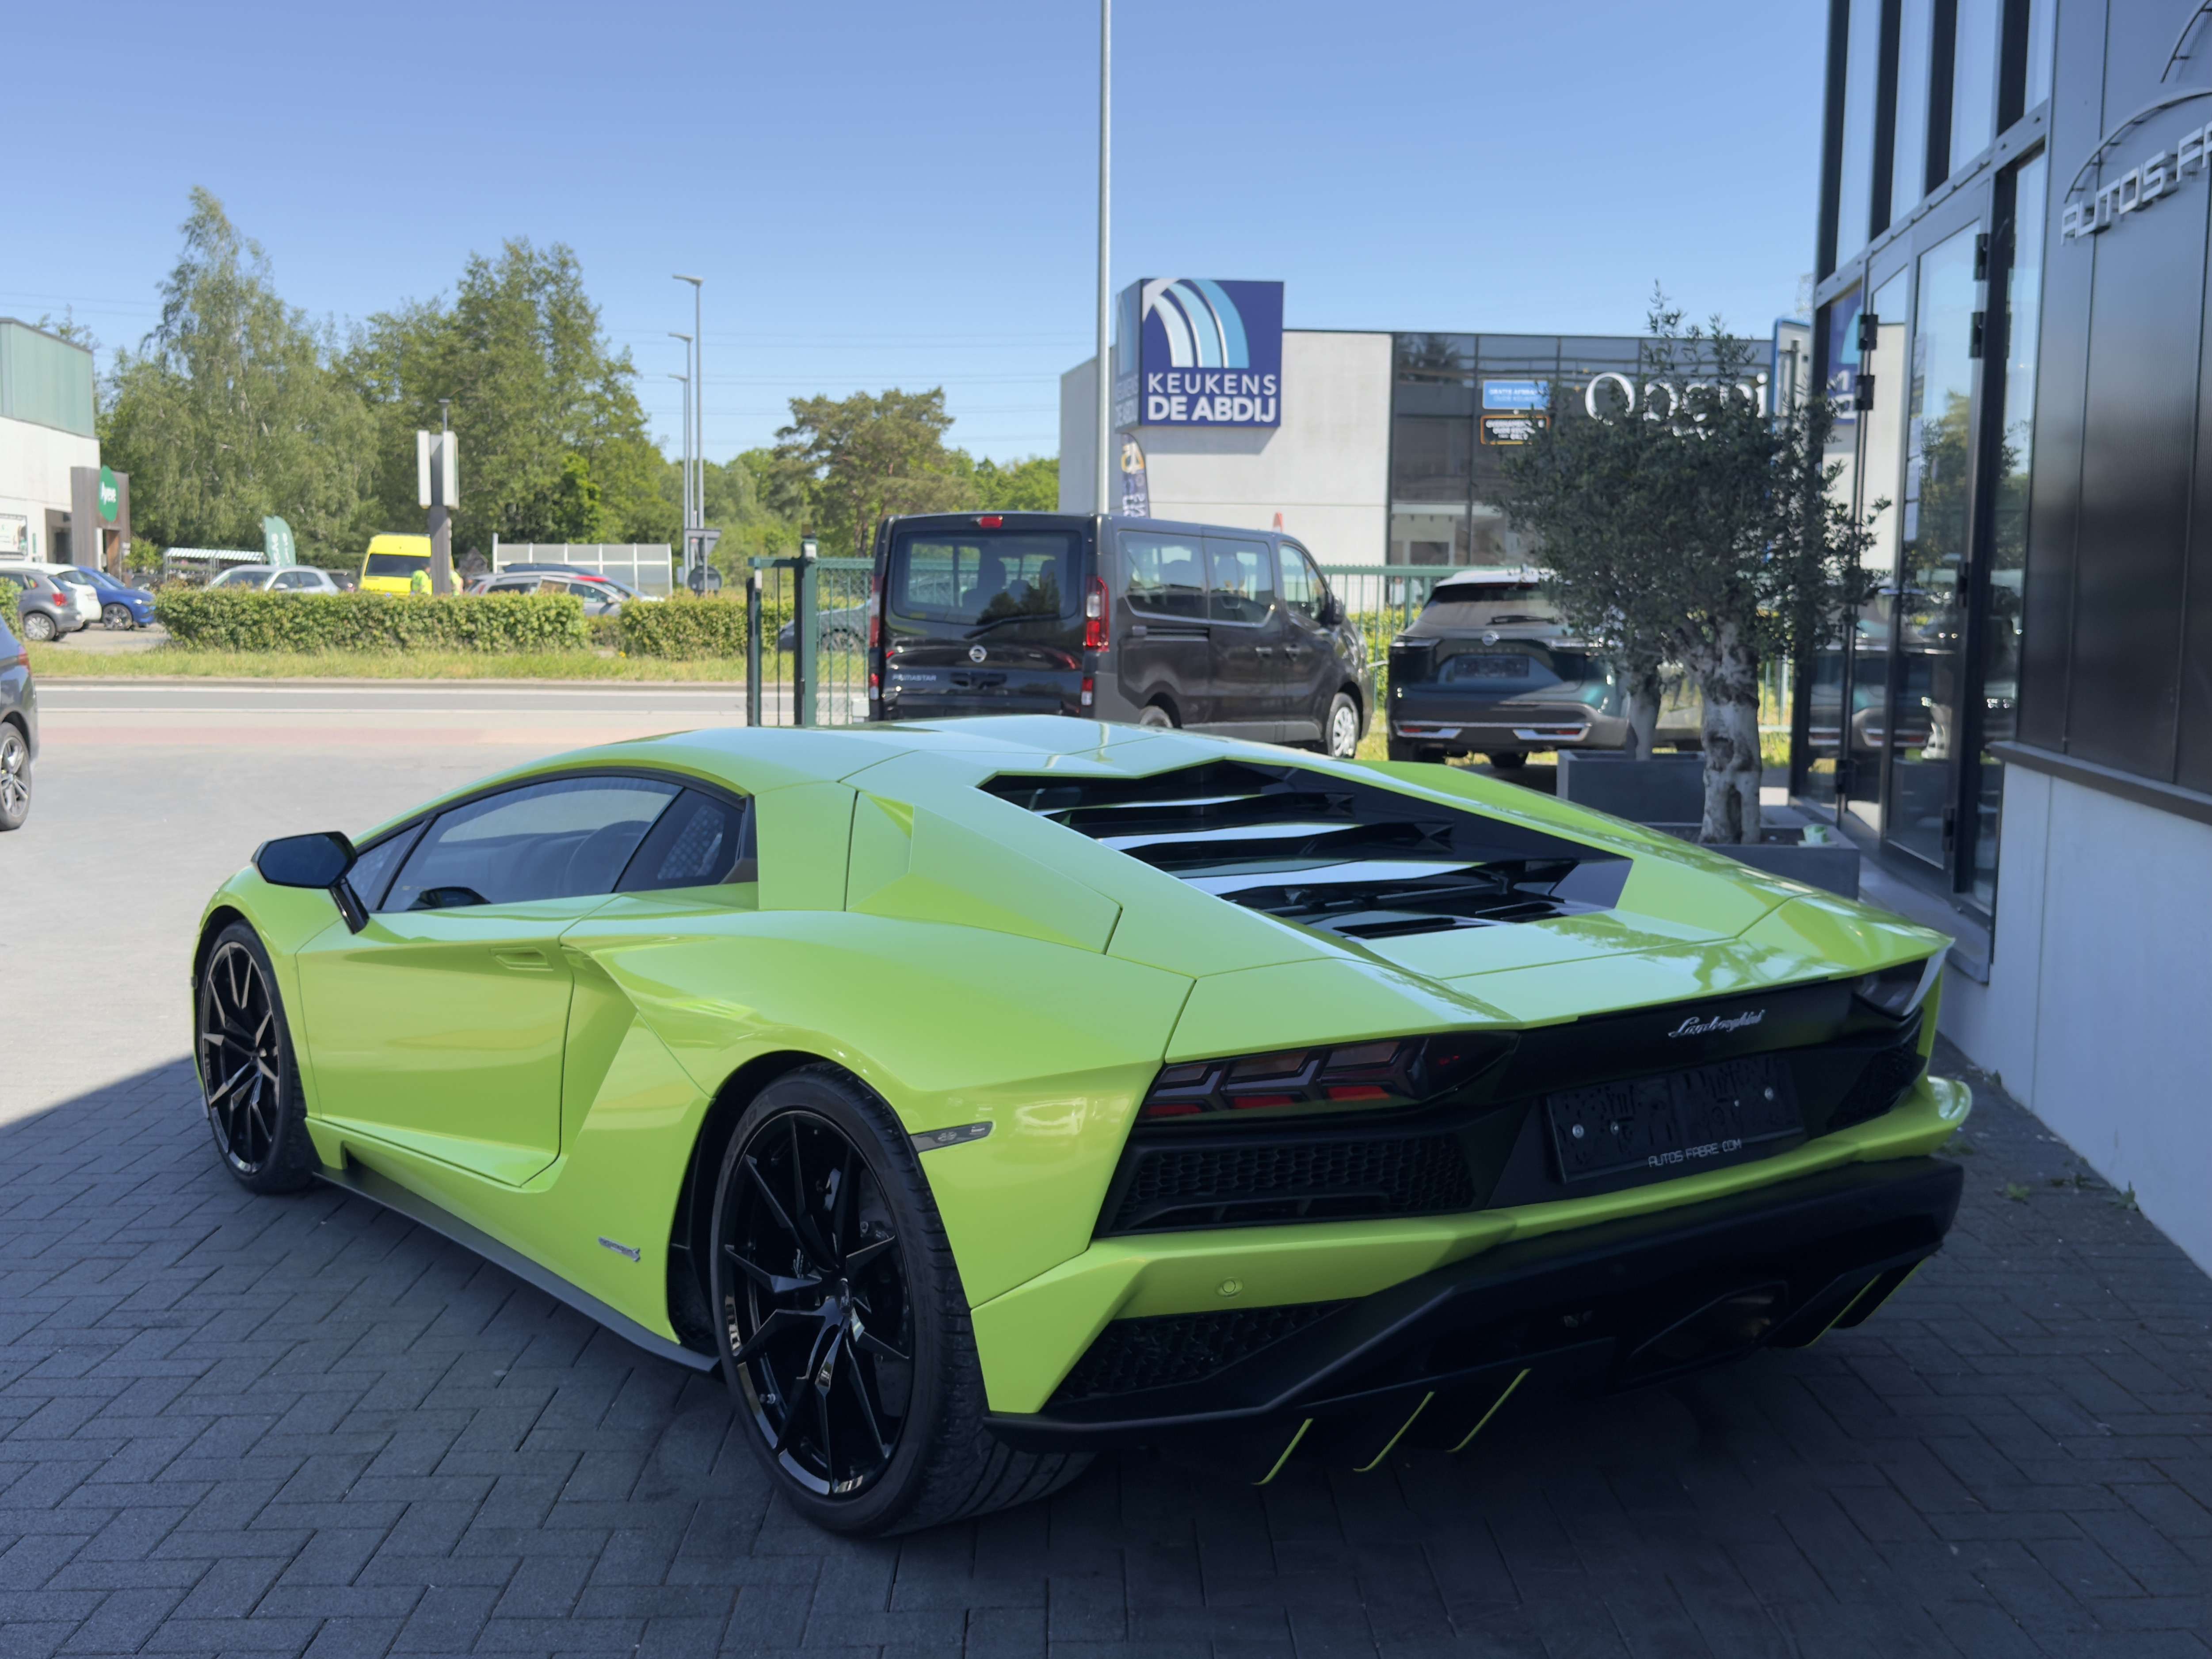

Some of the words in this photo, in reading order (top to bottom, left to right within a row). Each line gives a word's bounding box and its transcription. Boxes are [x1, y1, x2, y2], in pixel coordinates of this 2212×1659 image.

[2060, 149, 2166, 245] AUTOS
[1148, 373, 1277, 396] KEUKENS
[1148, 395, 1188, 421] DE
[1191, 396, 1277, 423] ABDIJ
[1668, 1009, 1766, 1037] Lamborghini
